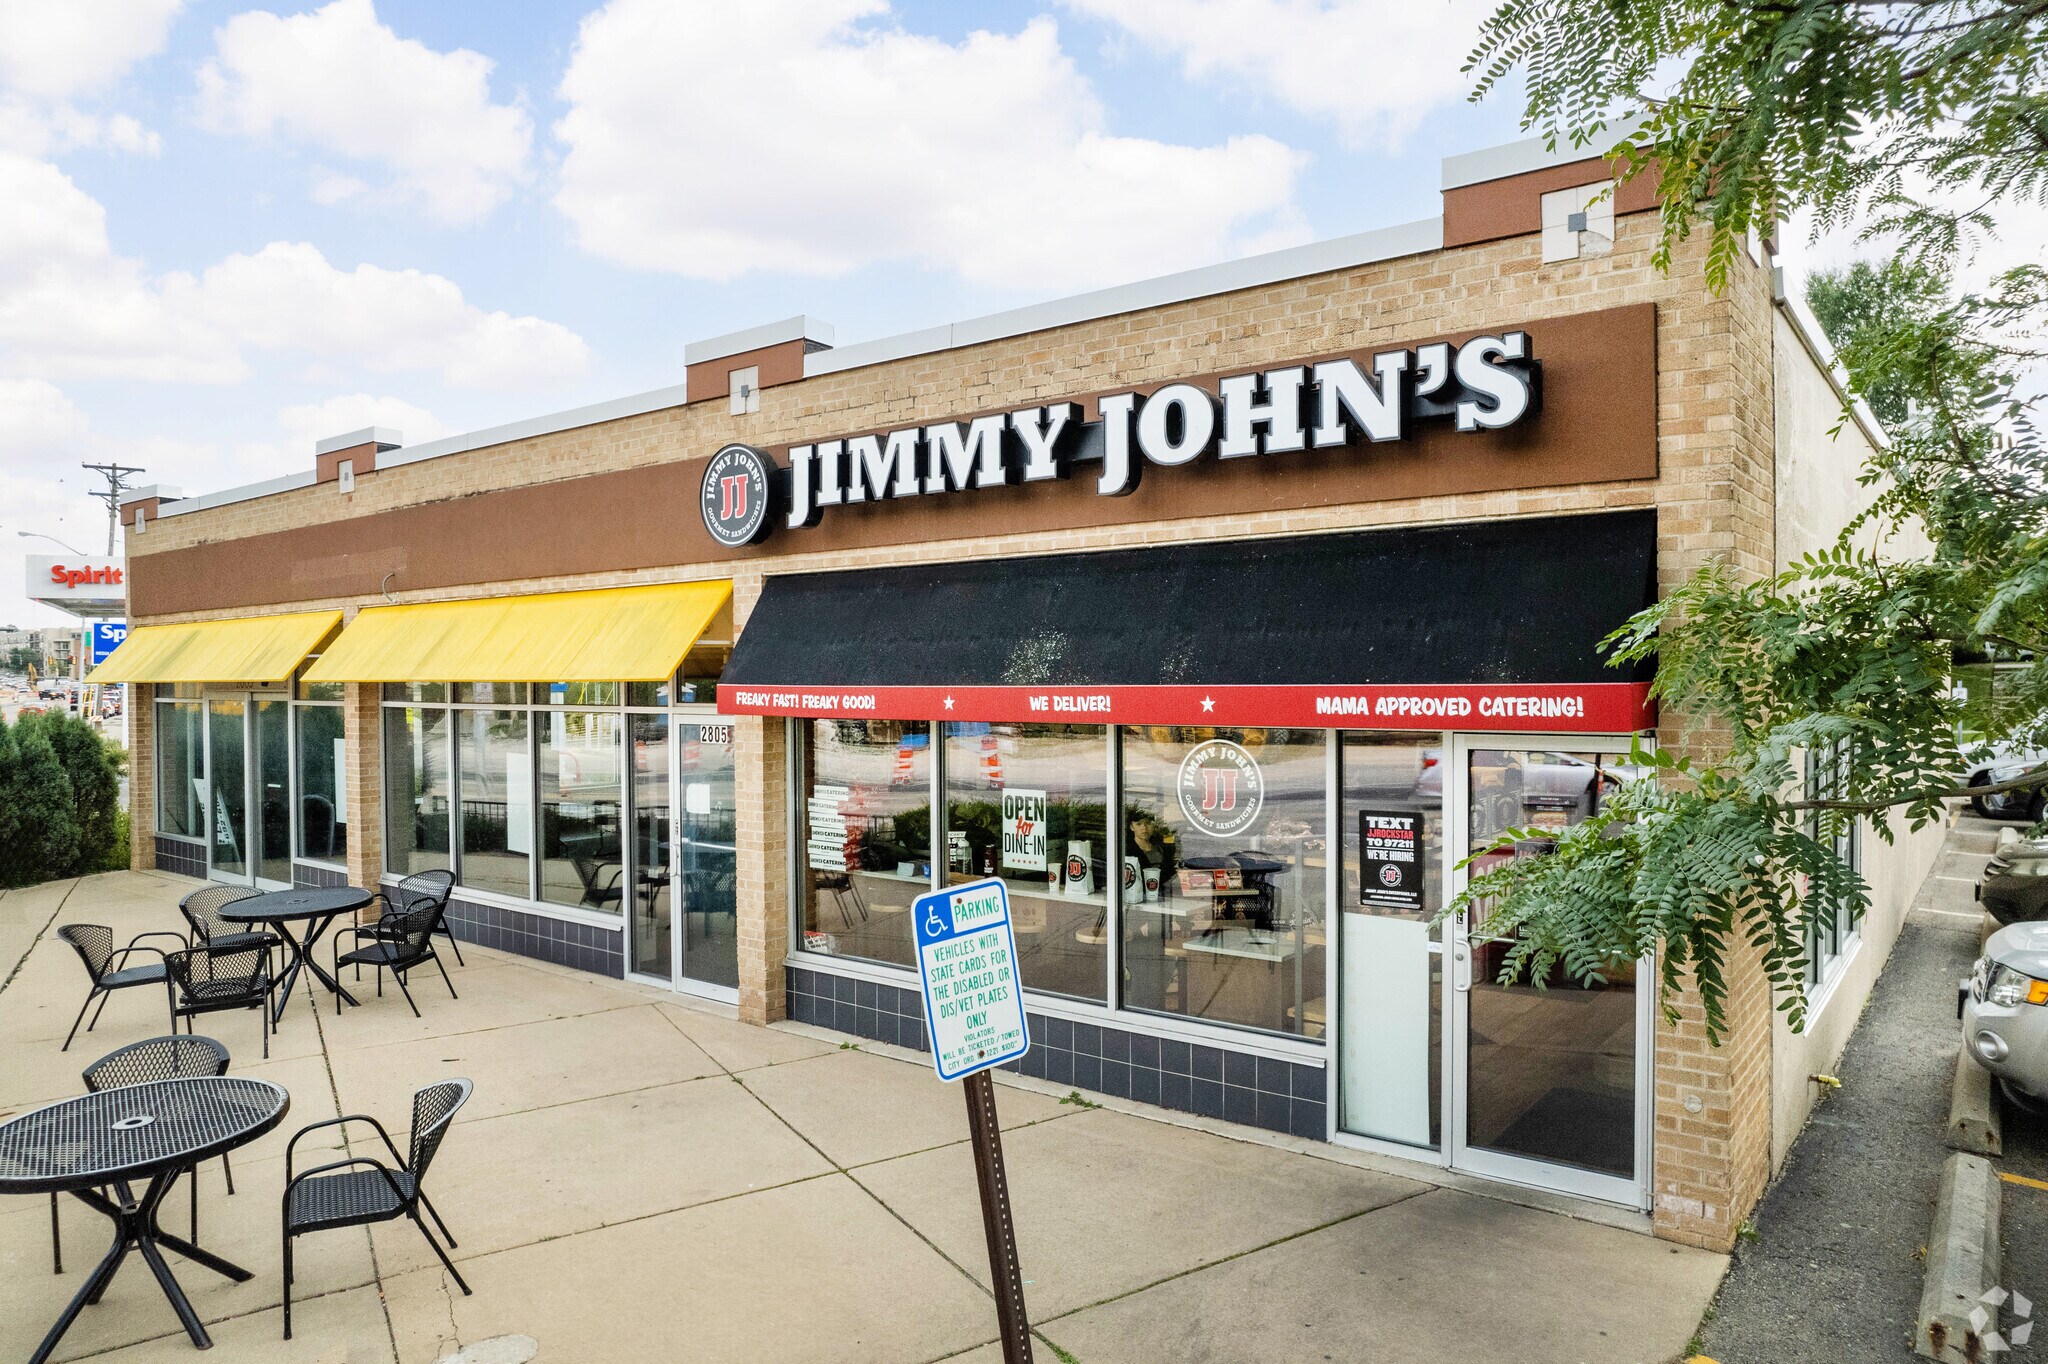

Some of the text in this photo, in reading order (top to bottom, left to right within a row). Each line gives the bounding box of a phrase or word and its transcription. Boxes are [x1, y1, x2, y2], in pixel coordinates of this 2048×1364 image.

[786, 330, 1529, 529] JIMMY JOHN'S
[706, 452, 762, 500] JIMMY JOHN'S
[720, 473, 749, 521] JJ
[707, 500, 762, 538] GOURMET SANDWICHES
[51, 564, 124, 589] Spirit
[735, 691, 876, 710] FREAKY FAST! FREAKY GOOD!
[1029, 695, 1111, 713] WE DELIVER!
[1315, 696, 1585, 717] MAMA APPROVED CATERING!
[701, 725, 727, 743] 2805
[1183, 747, 1257, 789] JIMMY JOHN'S
[1202, 768, 1238, 811] JJ
[1004, 794, 1045, 823] OPEN
[1185, 794, 1257, 830] GOURMET SANDWICHES
[824, 831, 848, 839] CATERING
[1015, 815, 1035, 840] for
[1366, 816, 1414, 830] TEXT
[1366, 829, 1414, 840] JJROCKSTAR
[1004, 832, 1045, 856] DINE-IN
[1366, 837, 1415, 849] TO 97211
[822, 858, 847, 867] CATERING
[1366, 849, 1415, 863] WE'RE HIRING
[954, 896, 1000, 923] PARKING
[934, 933, 999, 962] VEHICLES WITH
[931, 950, 1007, 983] STATE CARDS FOR
[933, 967, 1011, 1001] THE DISABLED OR
[940, 986, 1009, 1019] DIS/VET PLATES
[966, 1011, 987, 1029] ONLY
[942, 1052, 956, 1061] WILL
[957, 1047, 965, 1055] BE
[968, 1037, 995, 1052] TICKETED
[1000, 1029, 1020, 1040] TOWED
[963, 1026, 995, 1042] VIOLATORS
[947, 1060, 960, 1070] CITY
